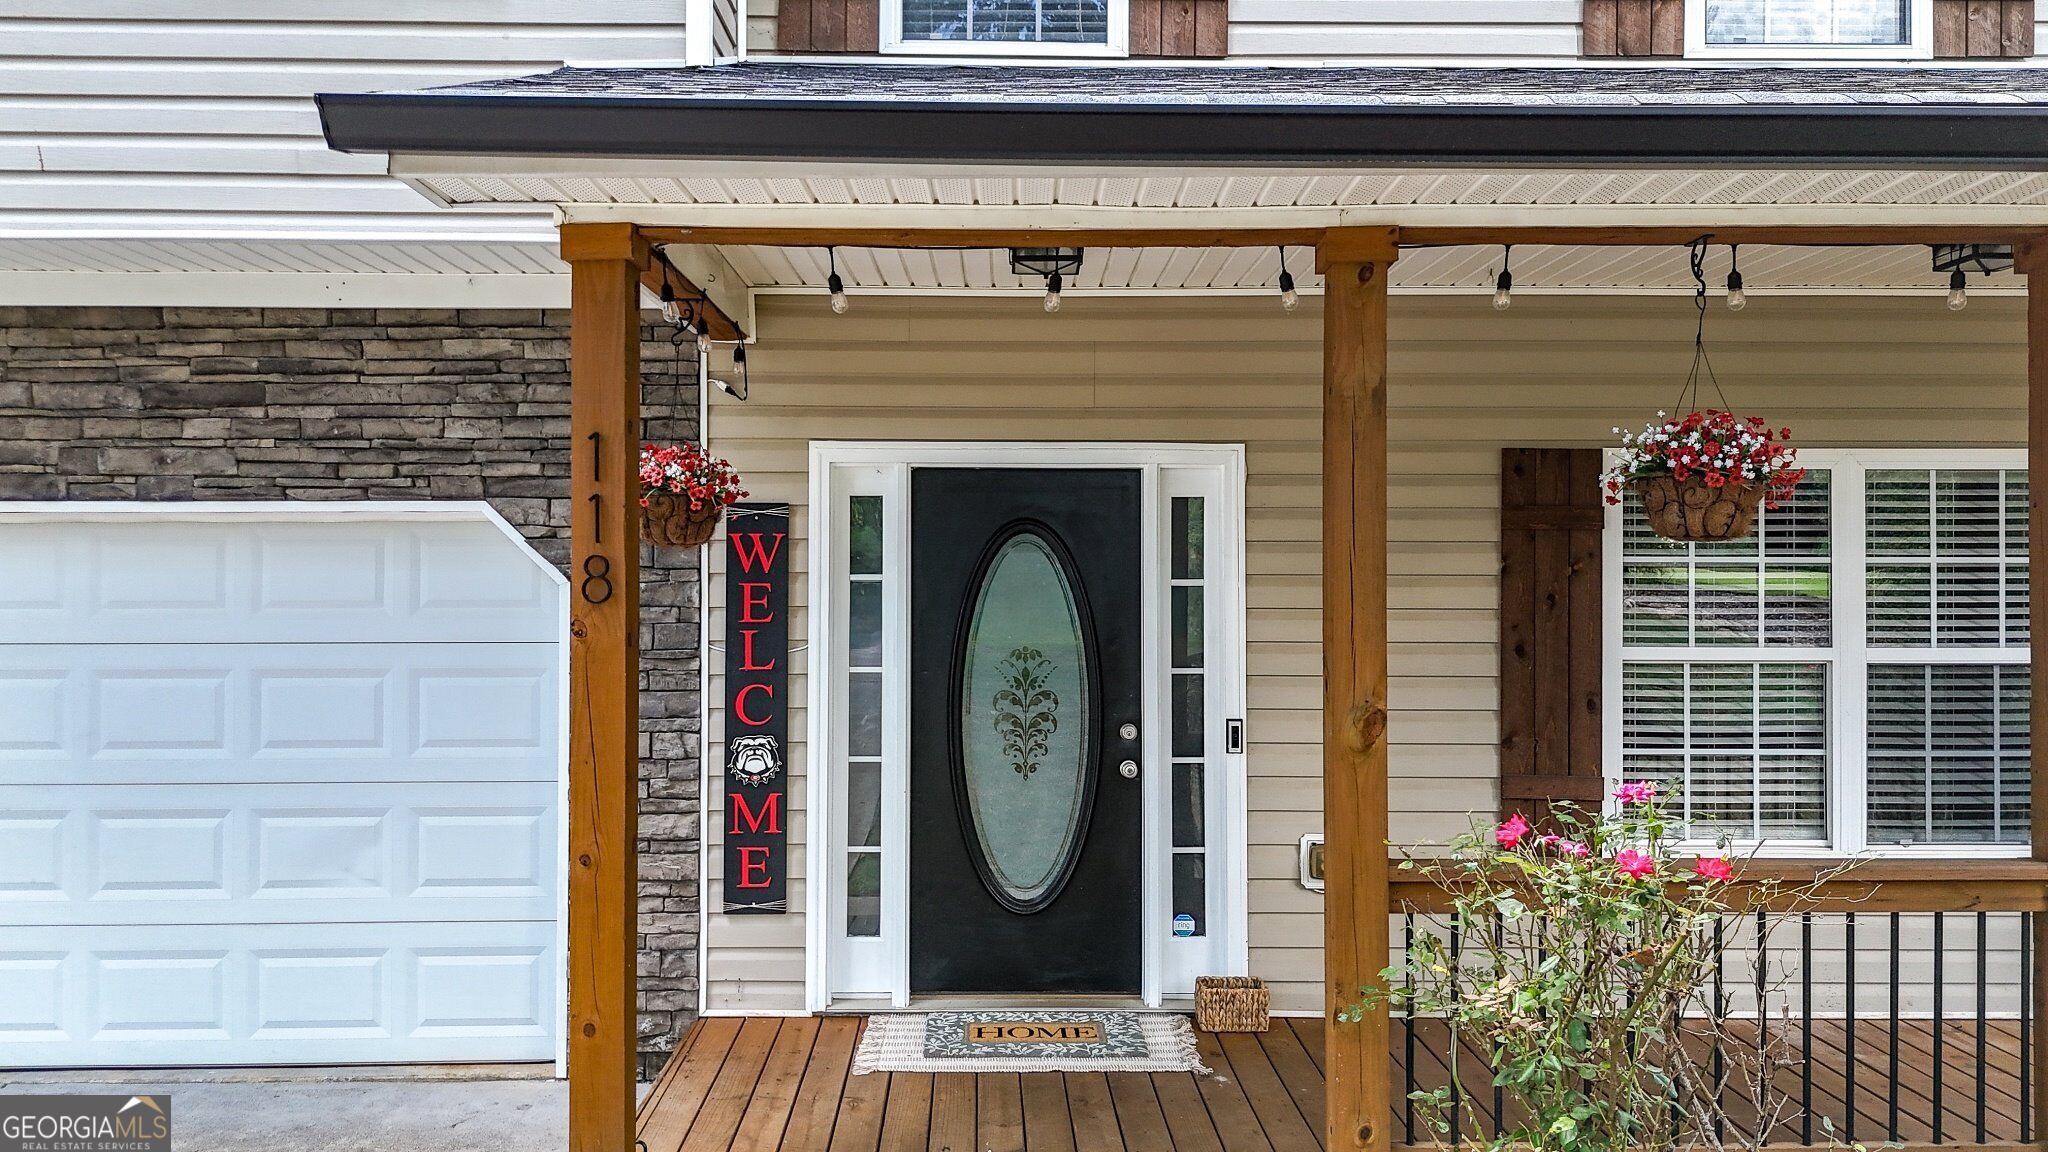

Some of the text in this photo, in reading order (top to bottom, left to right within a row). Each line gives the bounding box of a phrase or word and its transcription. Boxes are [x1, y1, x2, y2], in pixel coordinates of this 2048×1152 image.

[582, 431, 613, 604] 118
[1177, 921, 1191, 930] ring
[973, 1025, 1099, 1040] HOME
